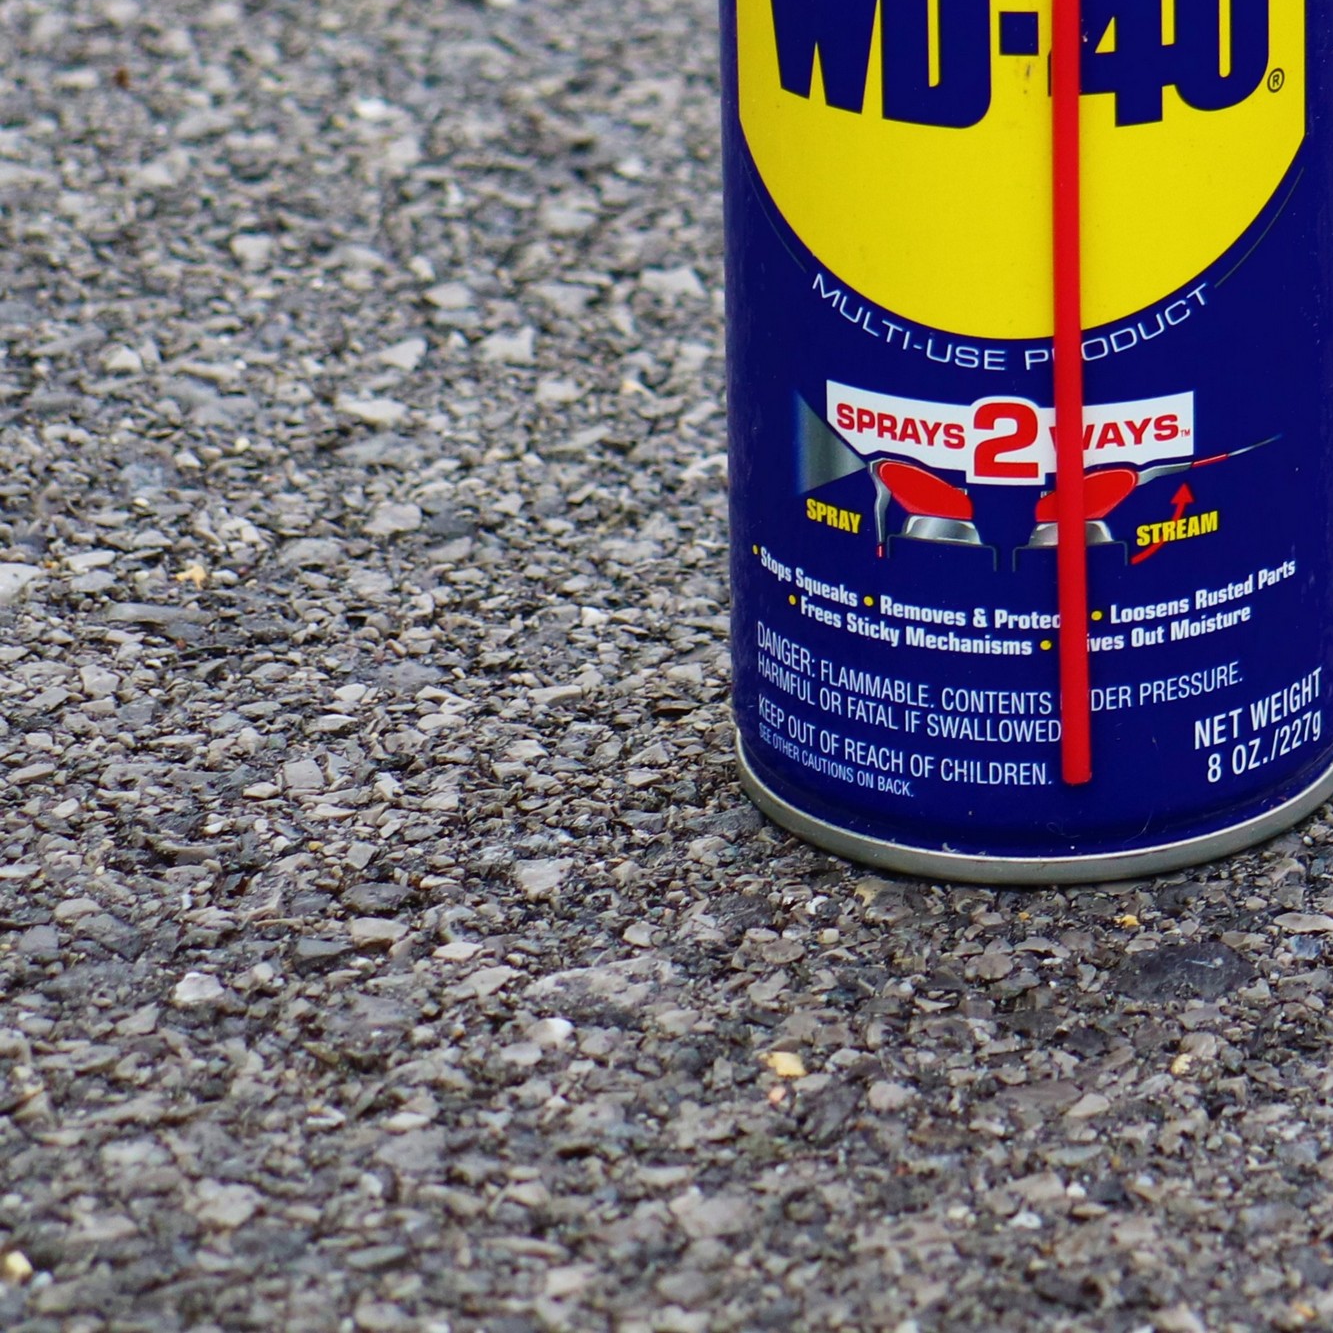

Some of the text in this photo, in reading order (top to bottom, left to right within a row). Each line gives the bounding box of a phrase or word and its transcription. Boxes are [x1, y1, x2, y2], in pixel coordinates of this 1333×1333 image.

[812, 273, 1208, 371] MULTI-USE PODUCT
[836, 402, 966, 450] SPRAYS
[973, 402, 1039, 479] 2
[806, 498, 862, 535] SPRAY
[1136, 510, 1219, 547] STREAM
[760, 546, 1296, 630] Stops Squeaks Removes & Protec Loosens Rusted Parts
[801, 594, 842, 629] Frees
[846, 612, 900, 648] Sticky
[905, 625, 1033, 656] Mechanisms
[1131, 627, 1165, 648] Out
[1170, 606, 1251, 642] Moisture
[757, 620, 1243, 715] DANGER: FLAMMABLE. CONTENTS DER PRESSURE.
[757, 651, 1062, 743] HARMFUL OR FATAL IF SWALLOWED
[758, 693, 1053, 786] KEEP OUT OF REACH OF CHILDREN.
[1194, 667, 1323, 750] NET WEIGHT
[1207, 710, 1323, 784] 8 OZ./227g
[758, 721, 915, 798] SEE OTHER CAUTIONS ON BACK.
